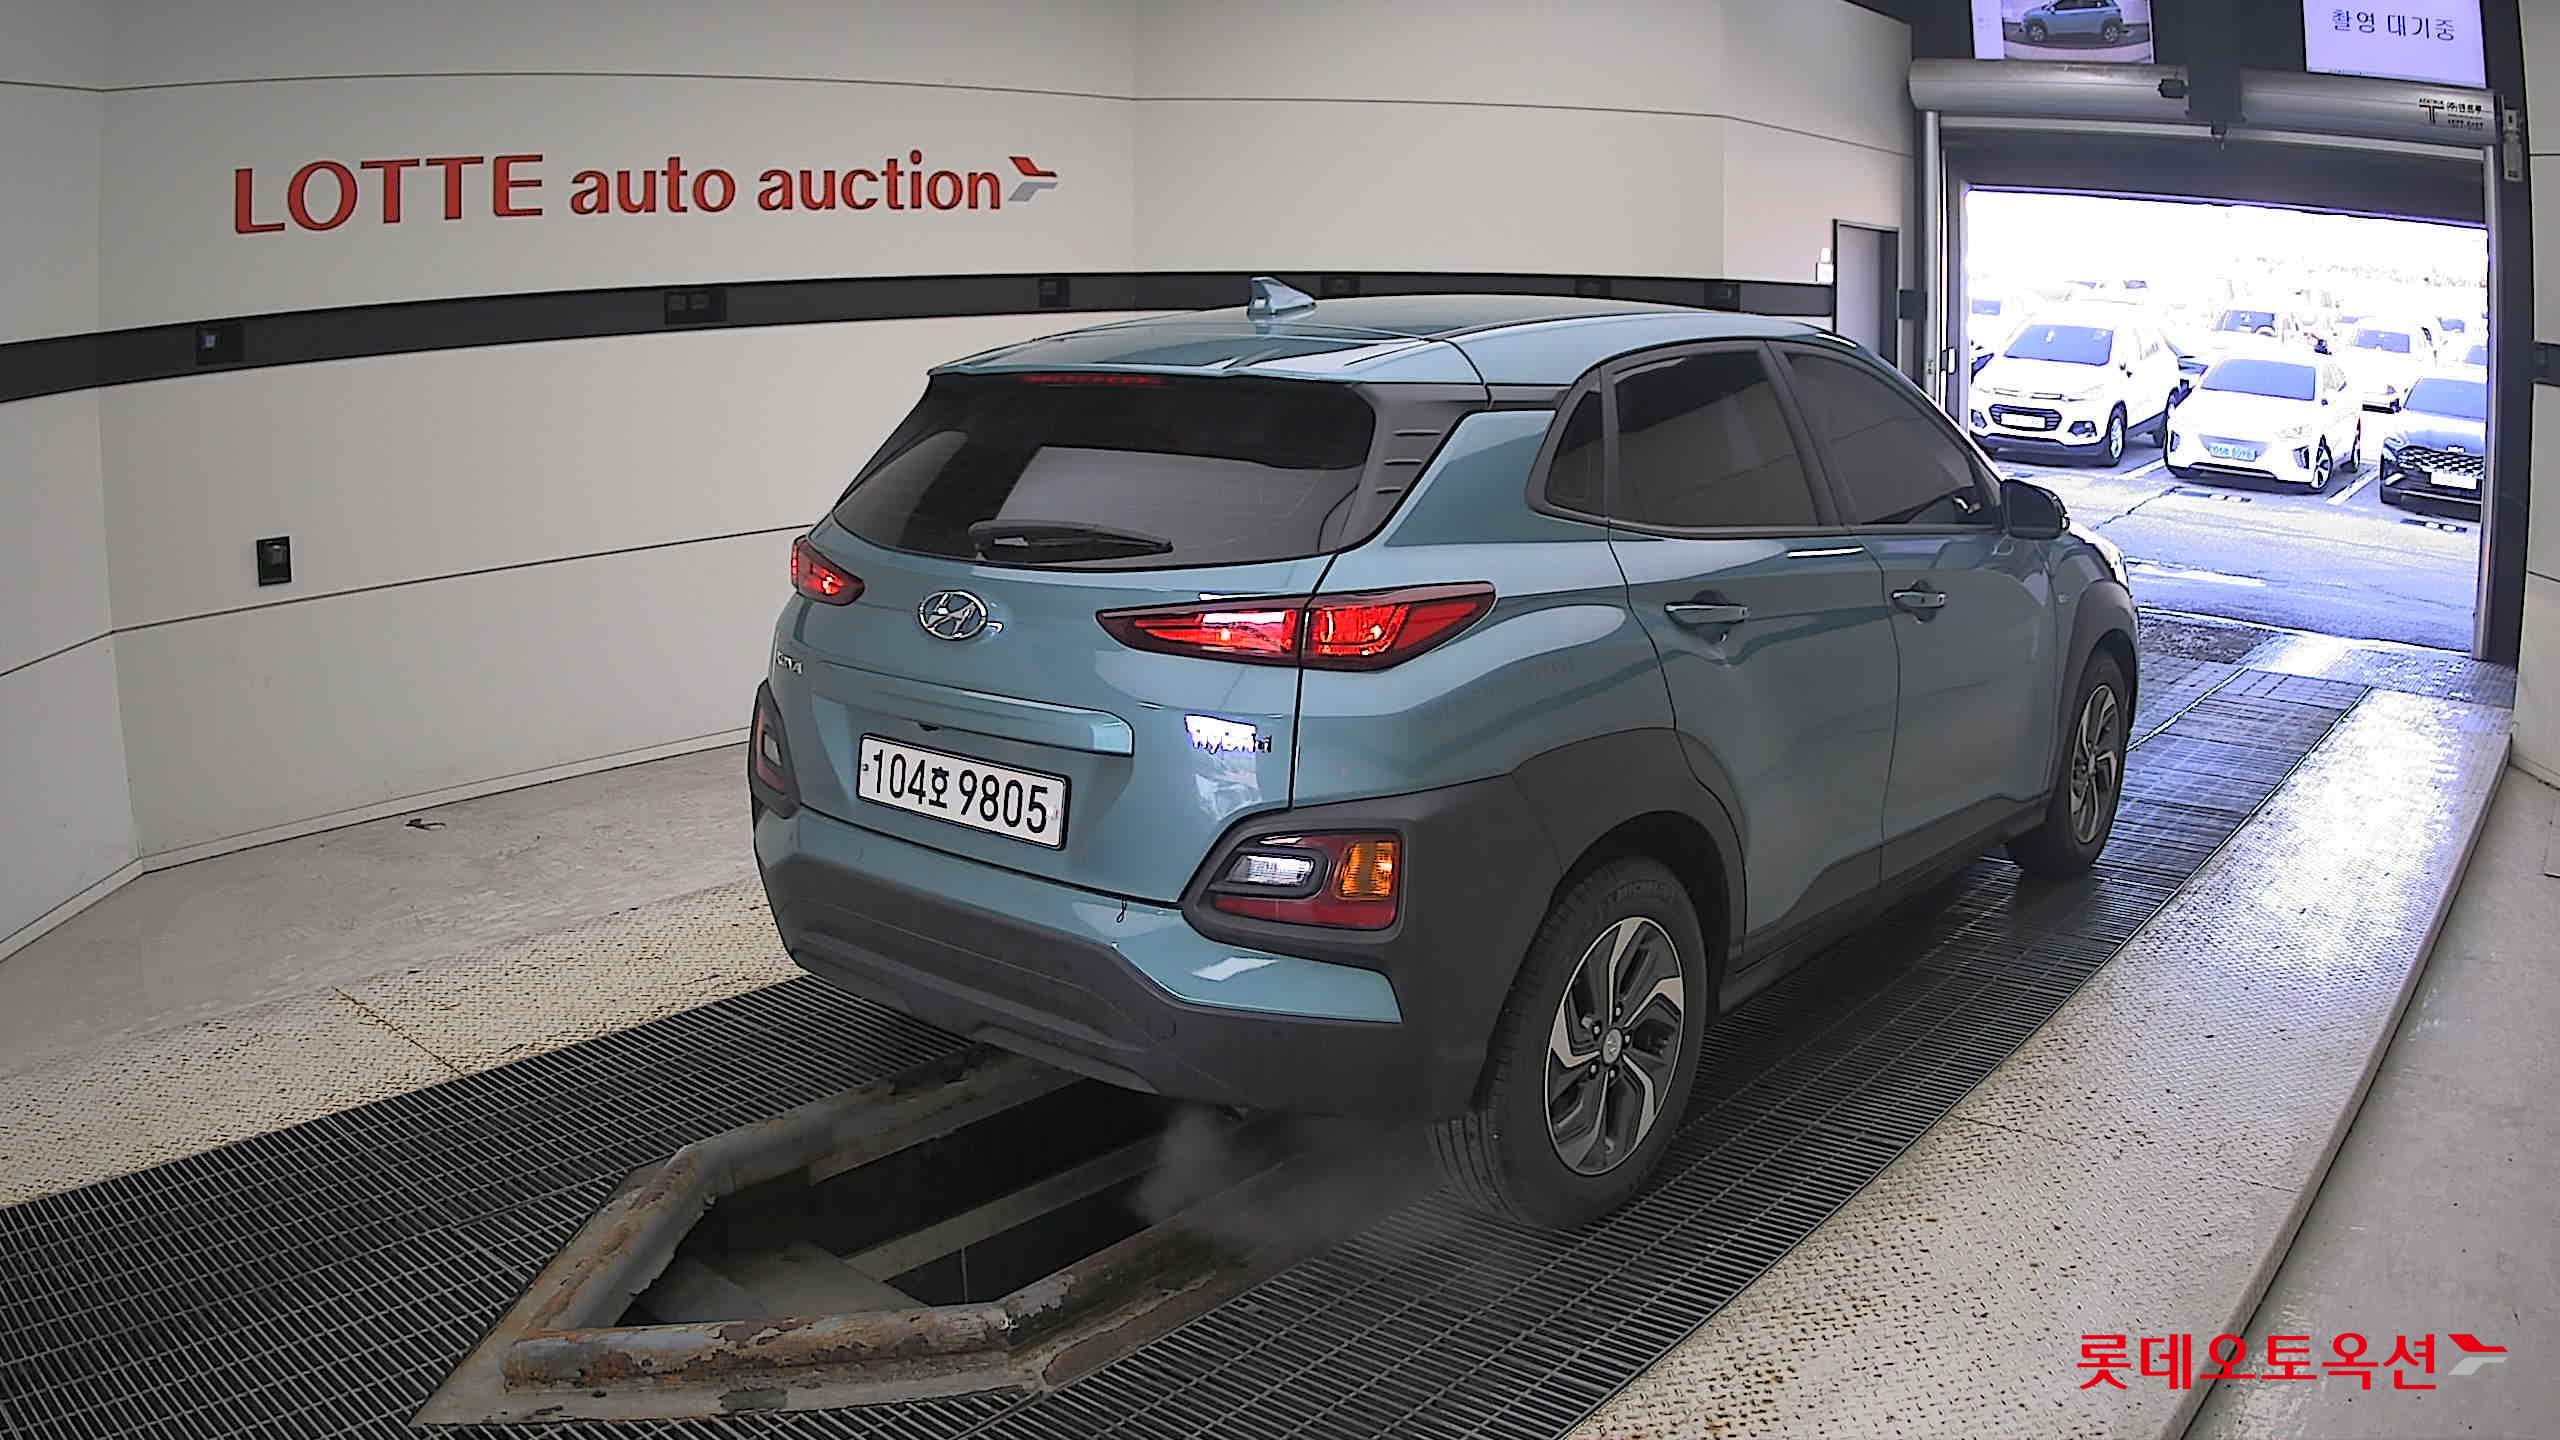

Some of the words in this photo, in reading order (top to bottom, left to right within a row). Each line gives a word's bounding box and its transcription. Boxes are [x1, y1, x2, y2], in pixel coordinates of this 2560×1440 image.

[2331, 9, 2376, 34] 촬영
[2386, 13, 2455, 42] 대기중
[237, 155, 543, 232] LOTTE
[569, 157, 738, 214] auto
[757, 151, 1002, 211] auction
[958, 769, 1049, 834] 9805
